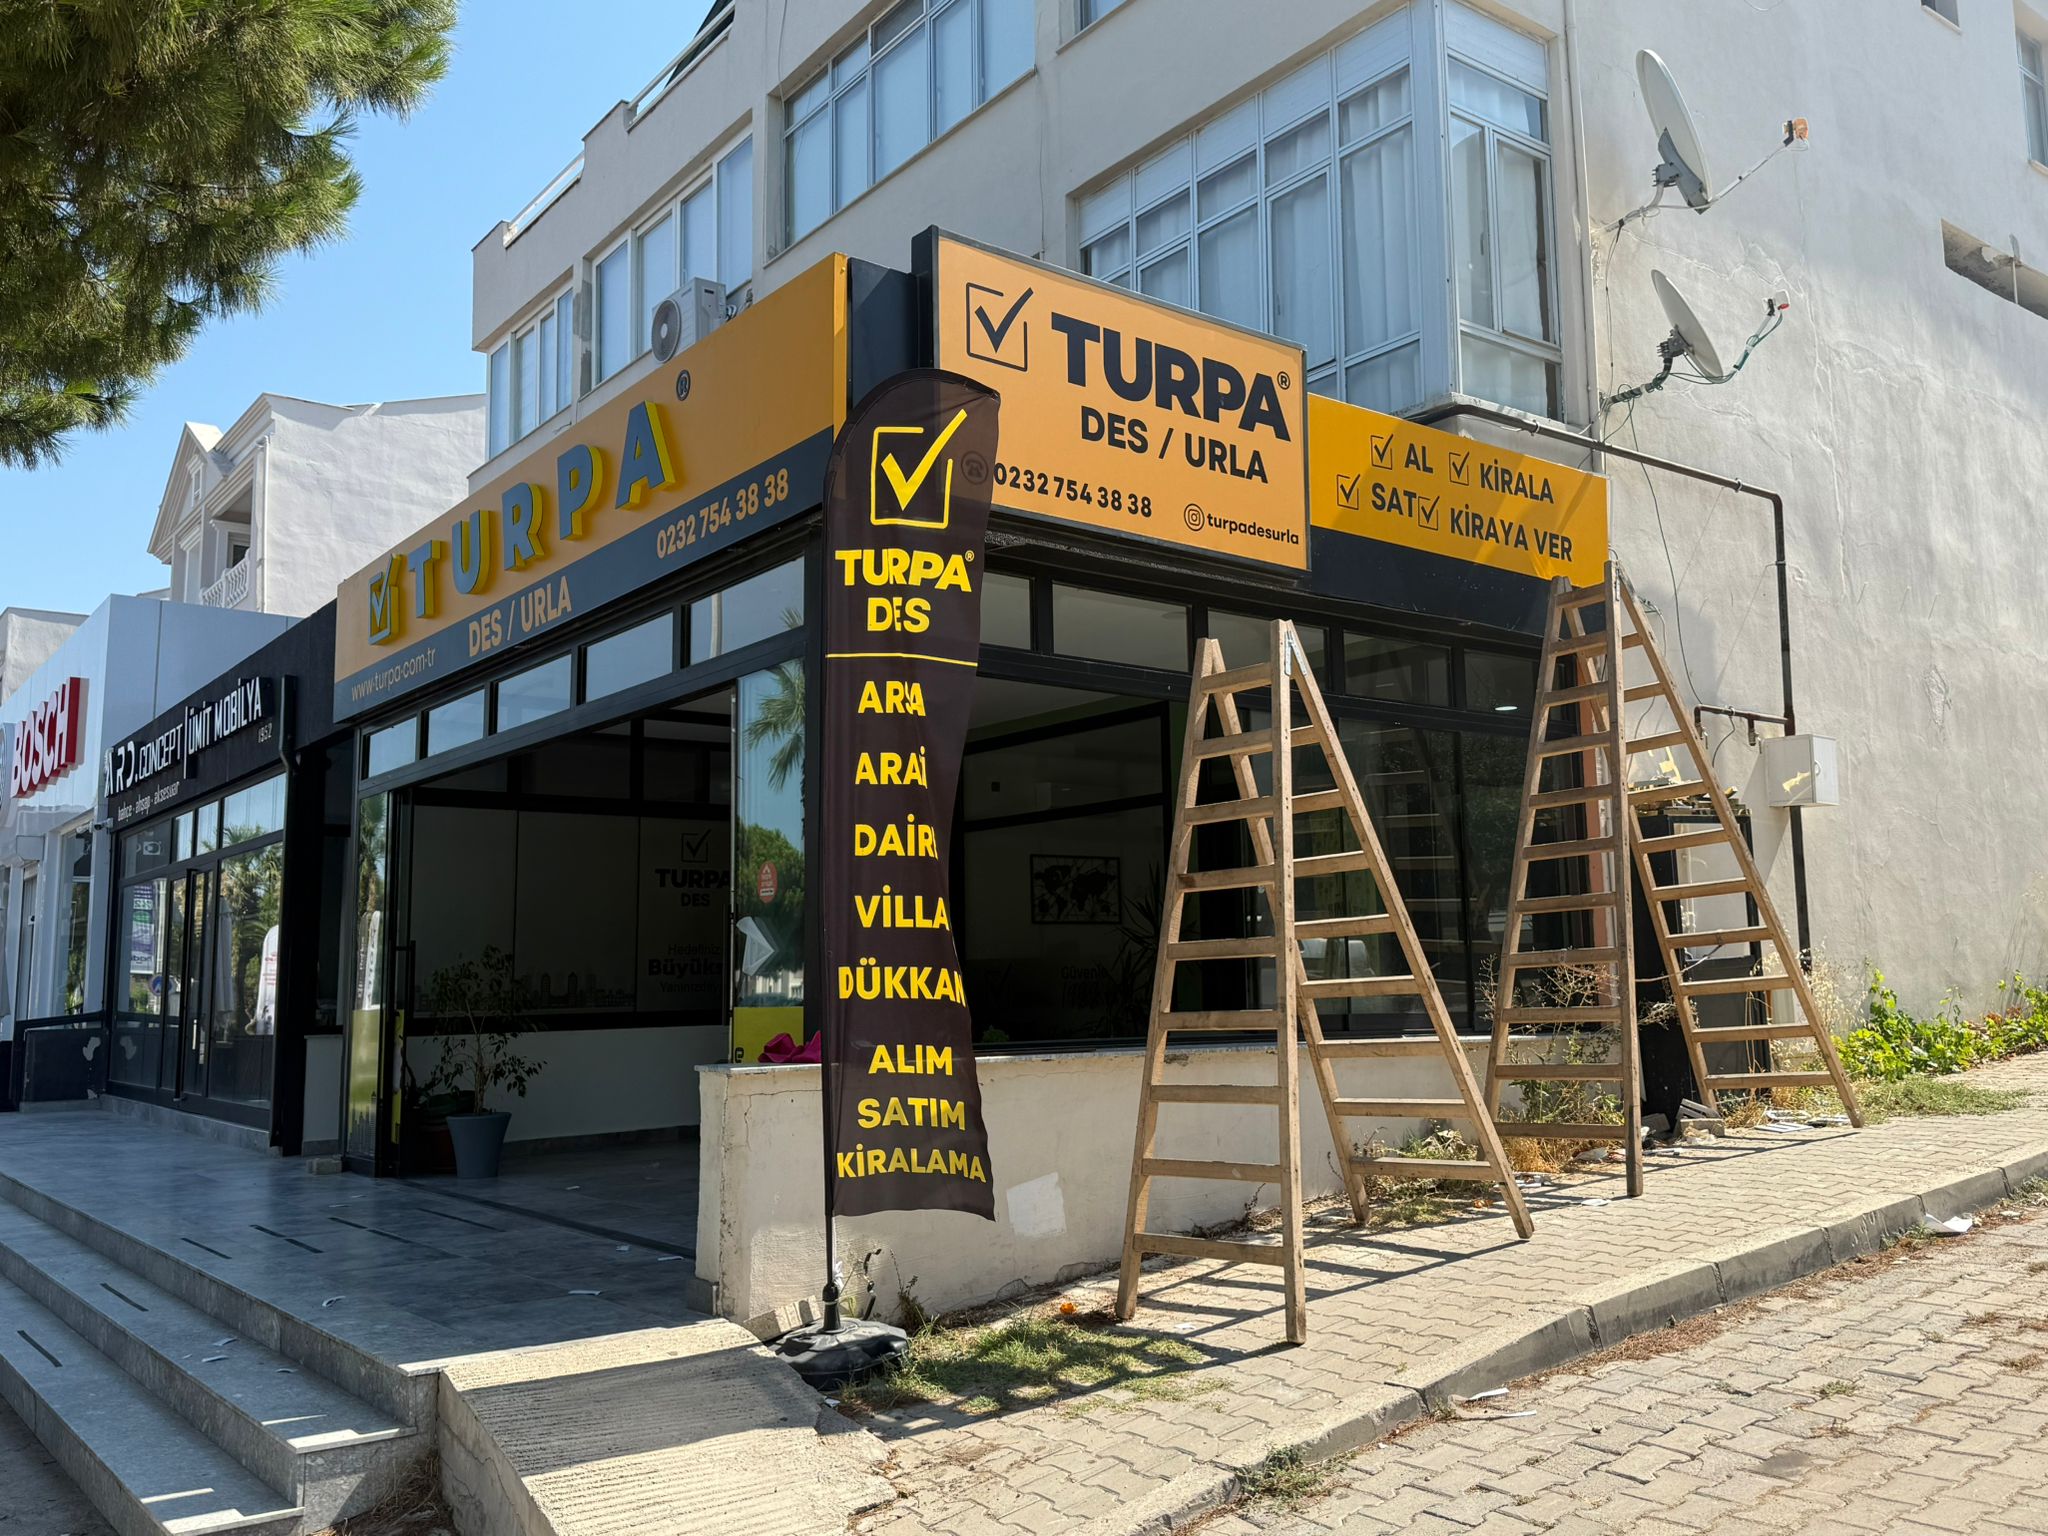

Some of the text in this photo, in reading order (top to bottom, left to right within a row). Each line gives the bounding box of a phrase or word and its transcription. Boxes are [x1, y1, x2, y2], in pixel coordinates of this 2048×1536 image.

[1081, 405, 1148, 454] DES
[1184, 433, 1268, 483] URLA
[993, 463, 1153, 518] 0232 754 38 38
[1404, 443, 1554, 504] AL KİRALA
[656, 468, 789, 559] 0232 754 38 38
[1206, 513, 1300, 545] turpadesurla
[1371, 483, 1572, 561] SAT KİRAYA VER
[469, 609, 502, 657] DES
[520, 575, 572, 632] URLA
[867, 596, 931, 633] DES
[11, 677, 79, 798] BOSCH
[188, 701, 212, 755] ÜMİT
[214, 676, 262, 742] MOBİLYA
[681, 892, 711, 908] DES
[854, 884, 950, 932] VİLLA
[868, 1044, 953, 1076] ALIM
[857, 1096, 966, 1131] SATIM
[836, 1143, 987, 1183] KİRALAMA
